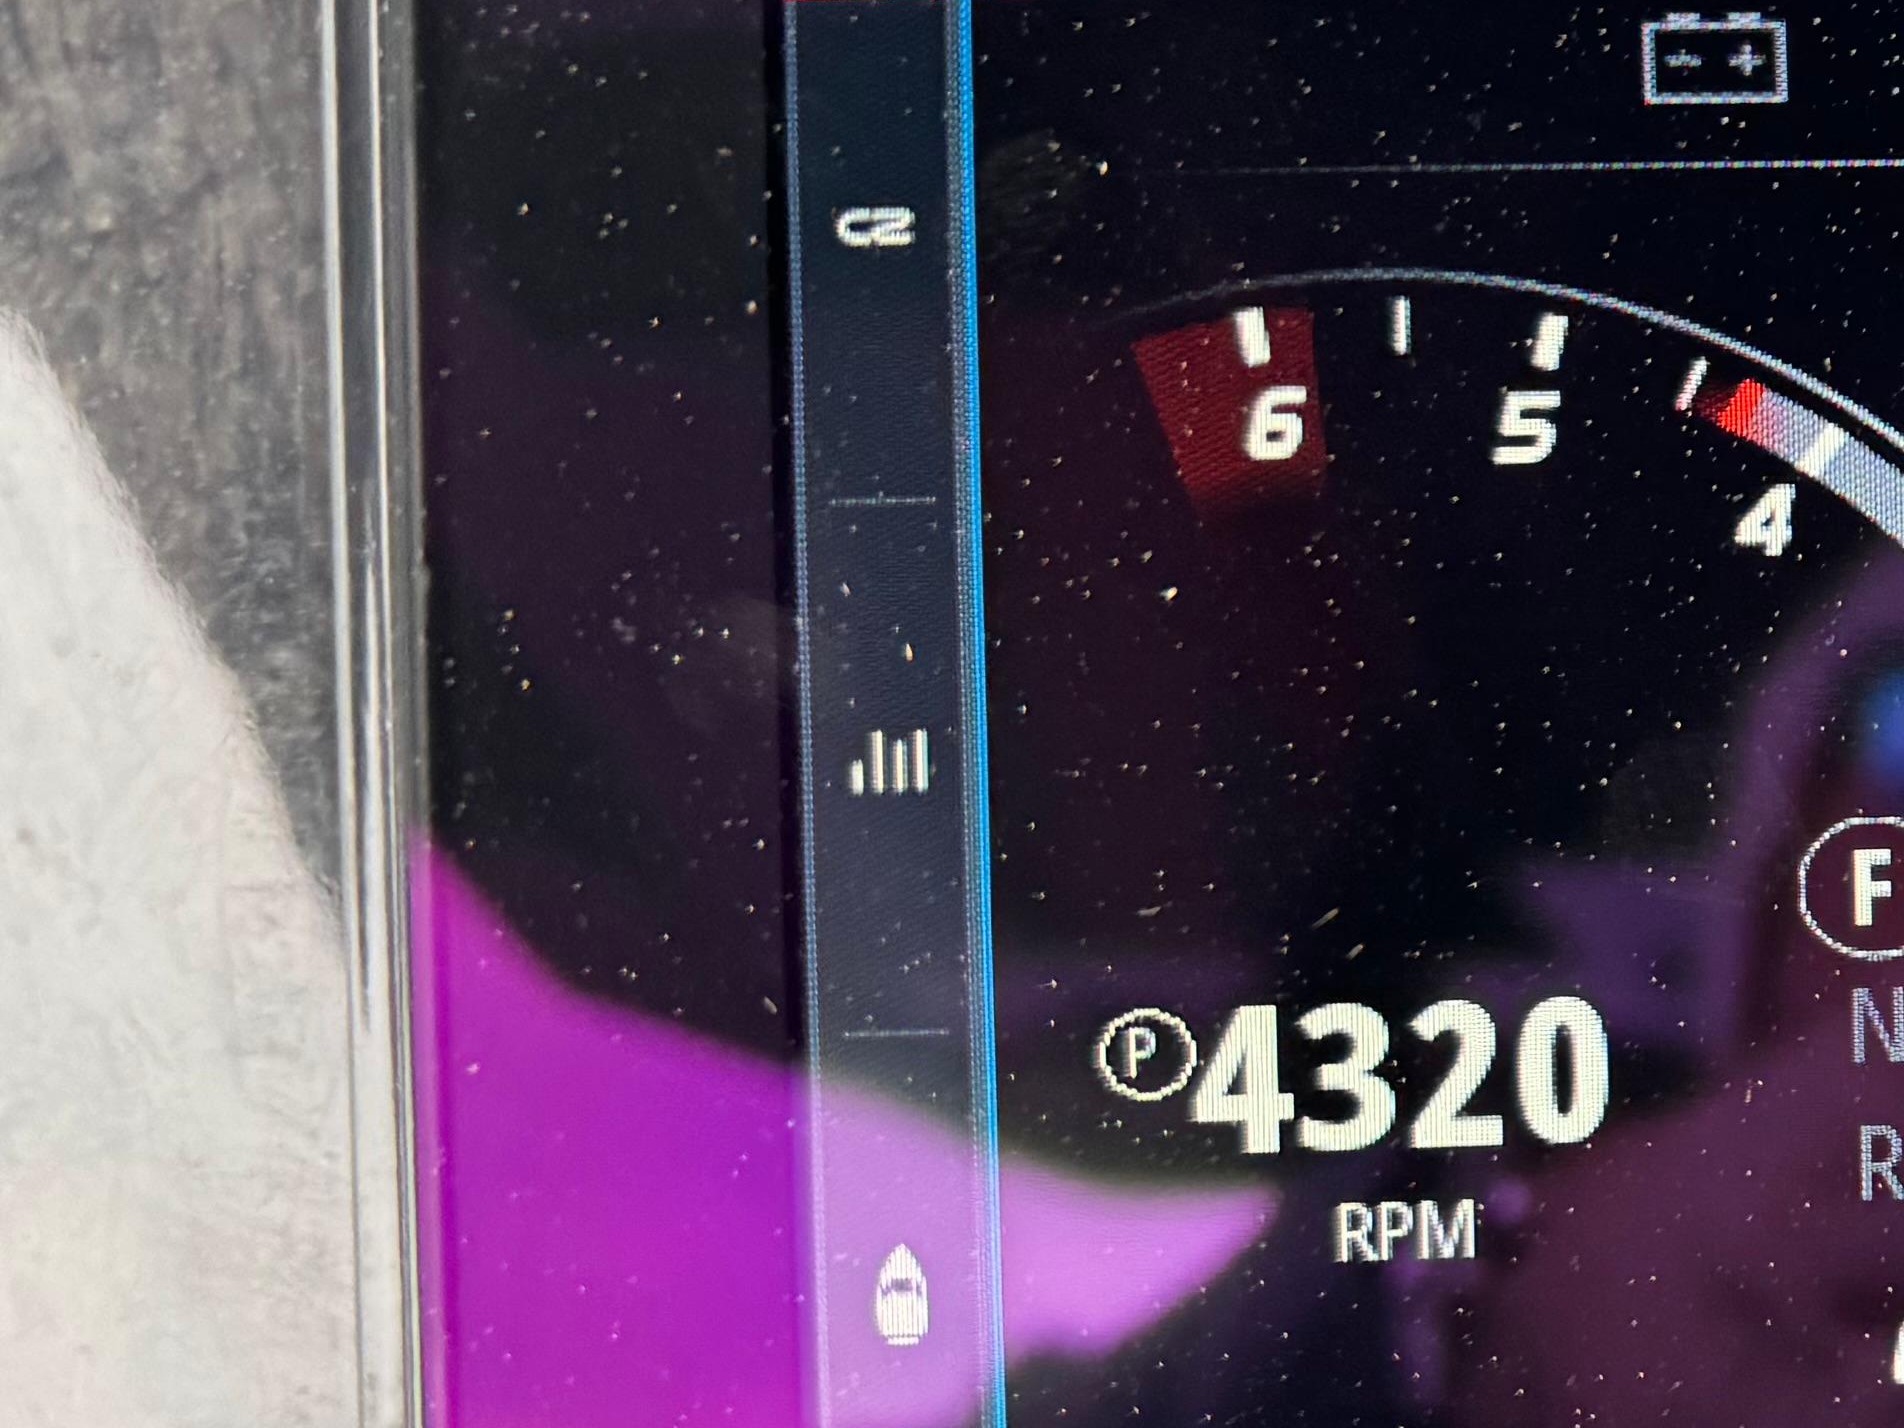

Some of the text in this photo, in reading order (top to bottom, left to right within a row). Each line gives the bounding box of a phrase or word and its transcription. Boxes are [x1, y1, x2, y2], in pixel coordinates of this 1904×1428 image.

[1242, 386, 1306, 462] 6
[1490, 390, 1562, 467] 5
[1735, 482, 1796, 557] 4
[1849, 848, 1896, 927] F
[1126, 1027, 1160, 1077] P
[1188, 995, 1609, 1155] 4320
[1334, 1199, 1478, 1263] RPM
